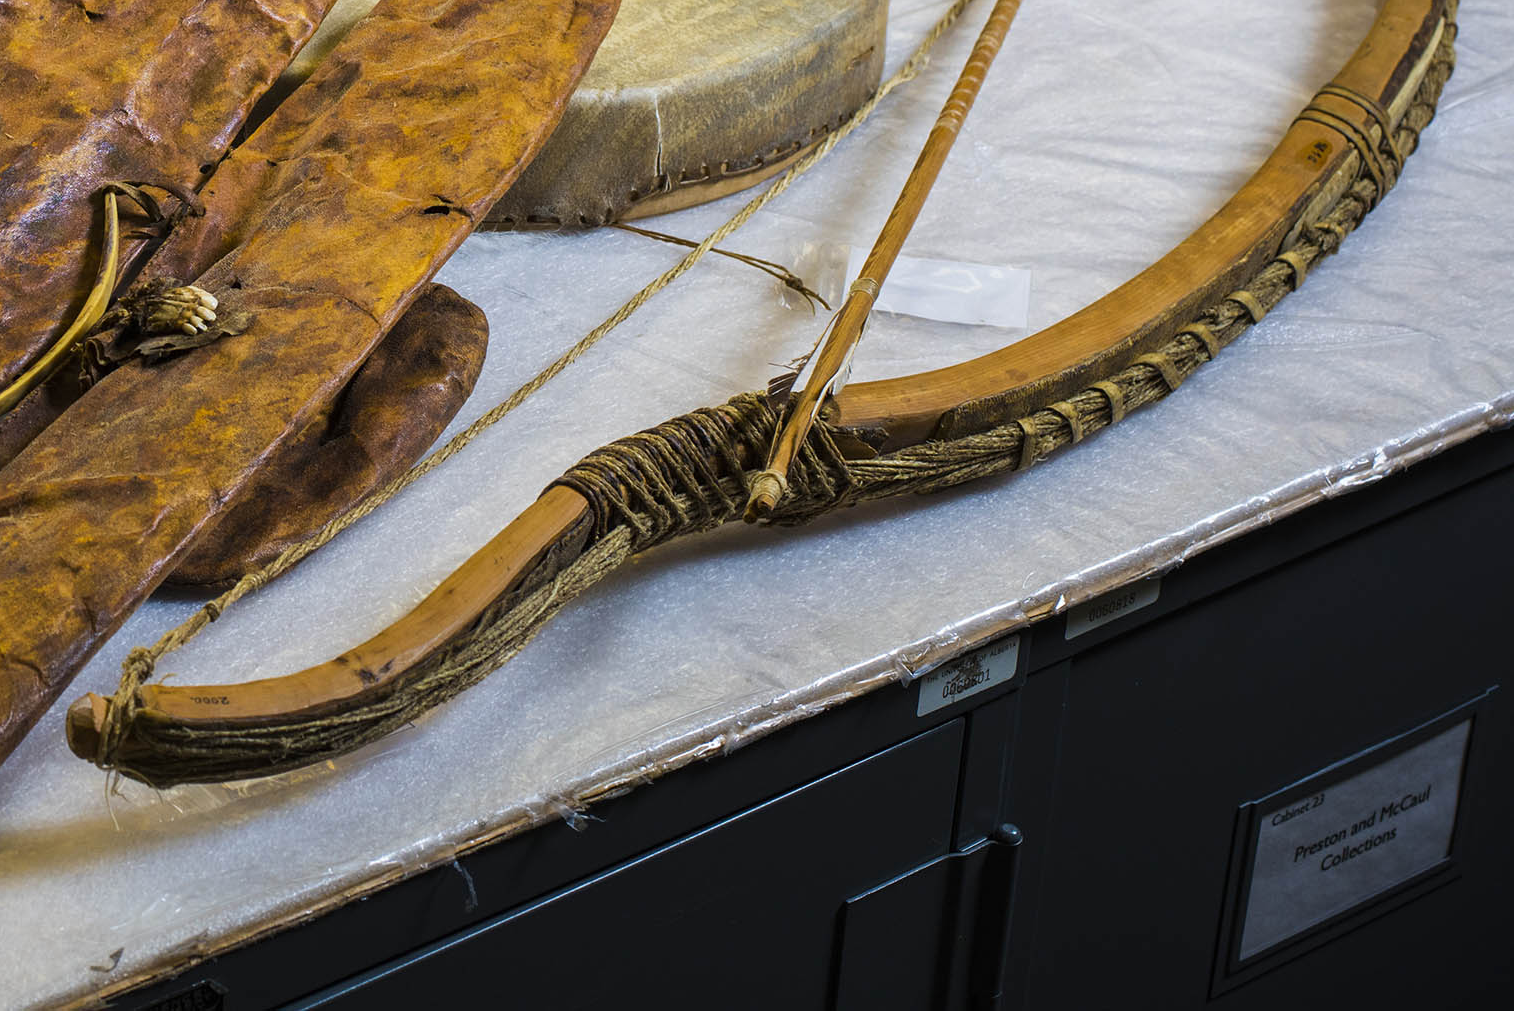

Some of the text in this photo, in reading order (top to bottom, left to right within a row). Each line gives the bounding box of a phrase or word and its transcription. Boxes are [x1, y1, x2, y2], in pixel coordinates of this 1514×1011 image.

[1271, 793, 1326, 827] Cabinet 23
[1294, 784, 1432, 863] Preston and McCaul
[1320, 827, 1398, 872] Collections
